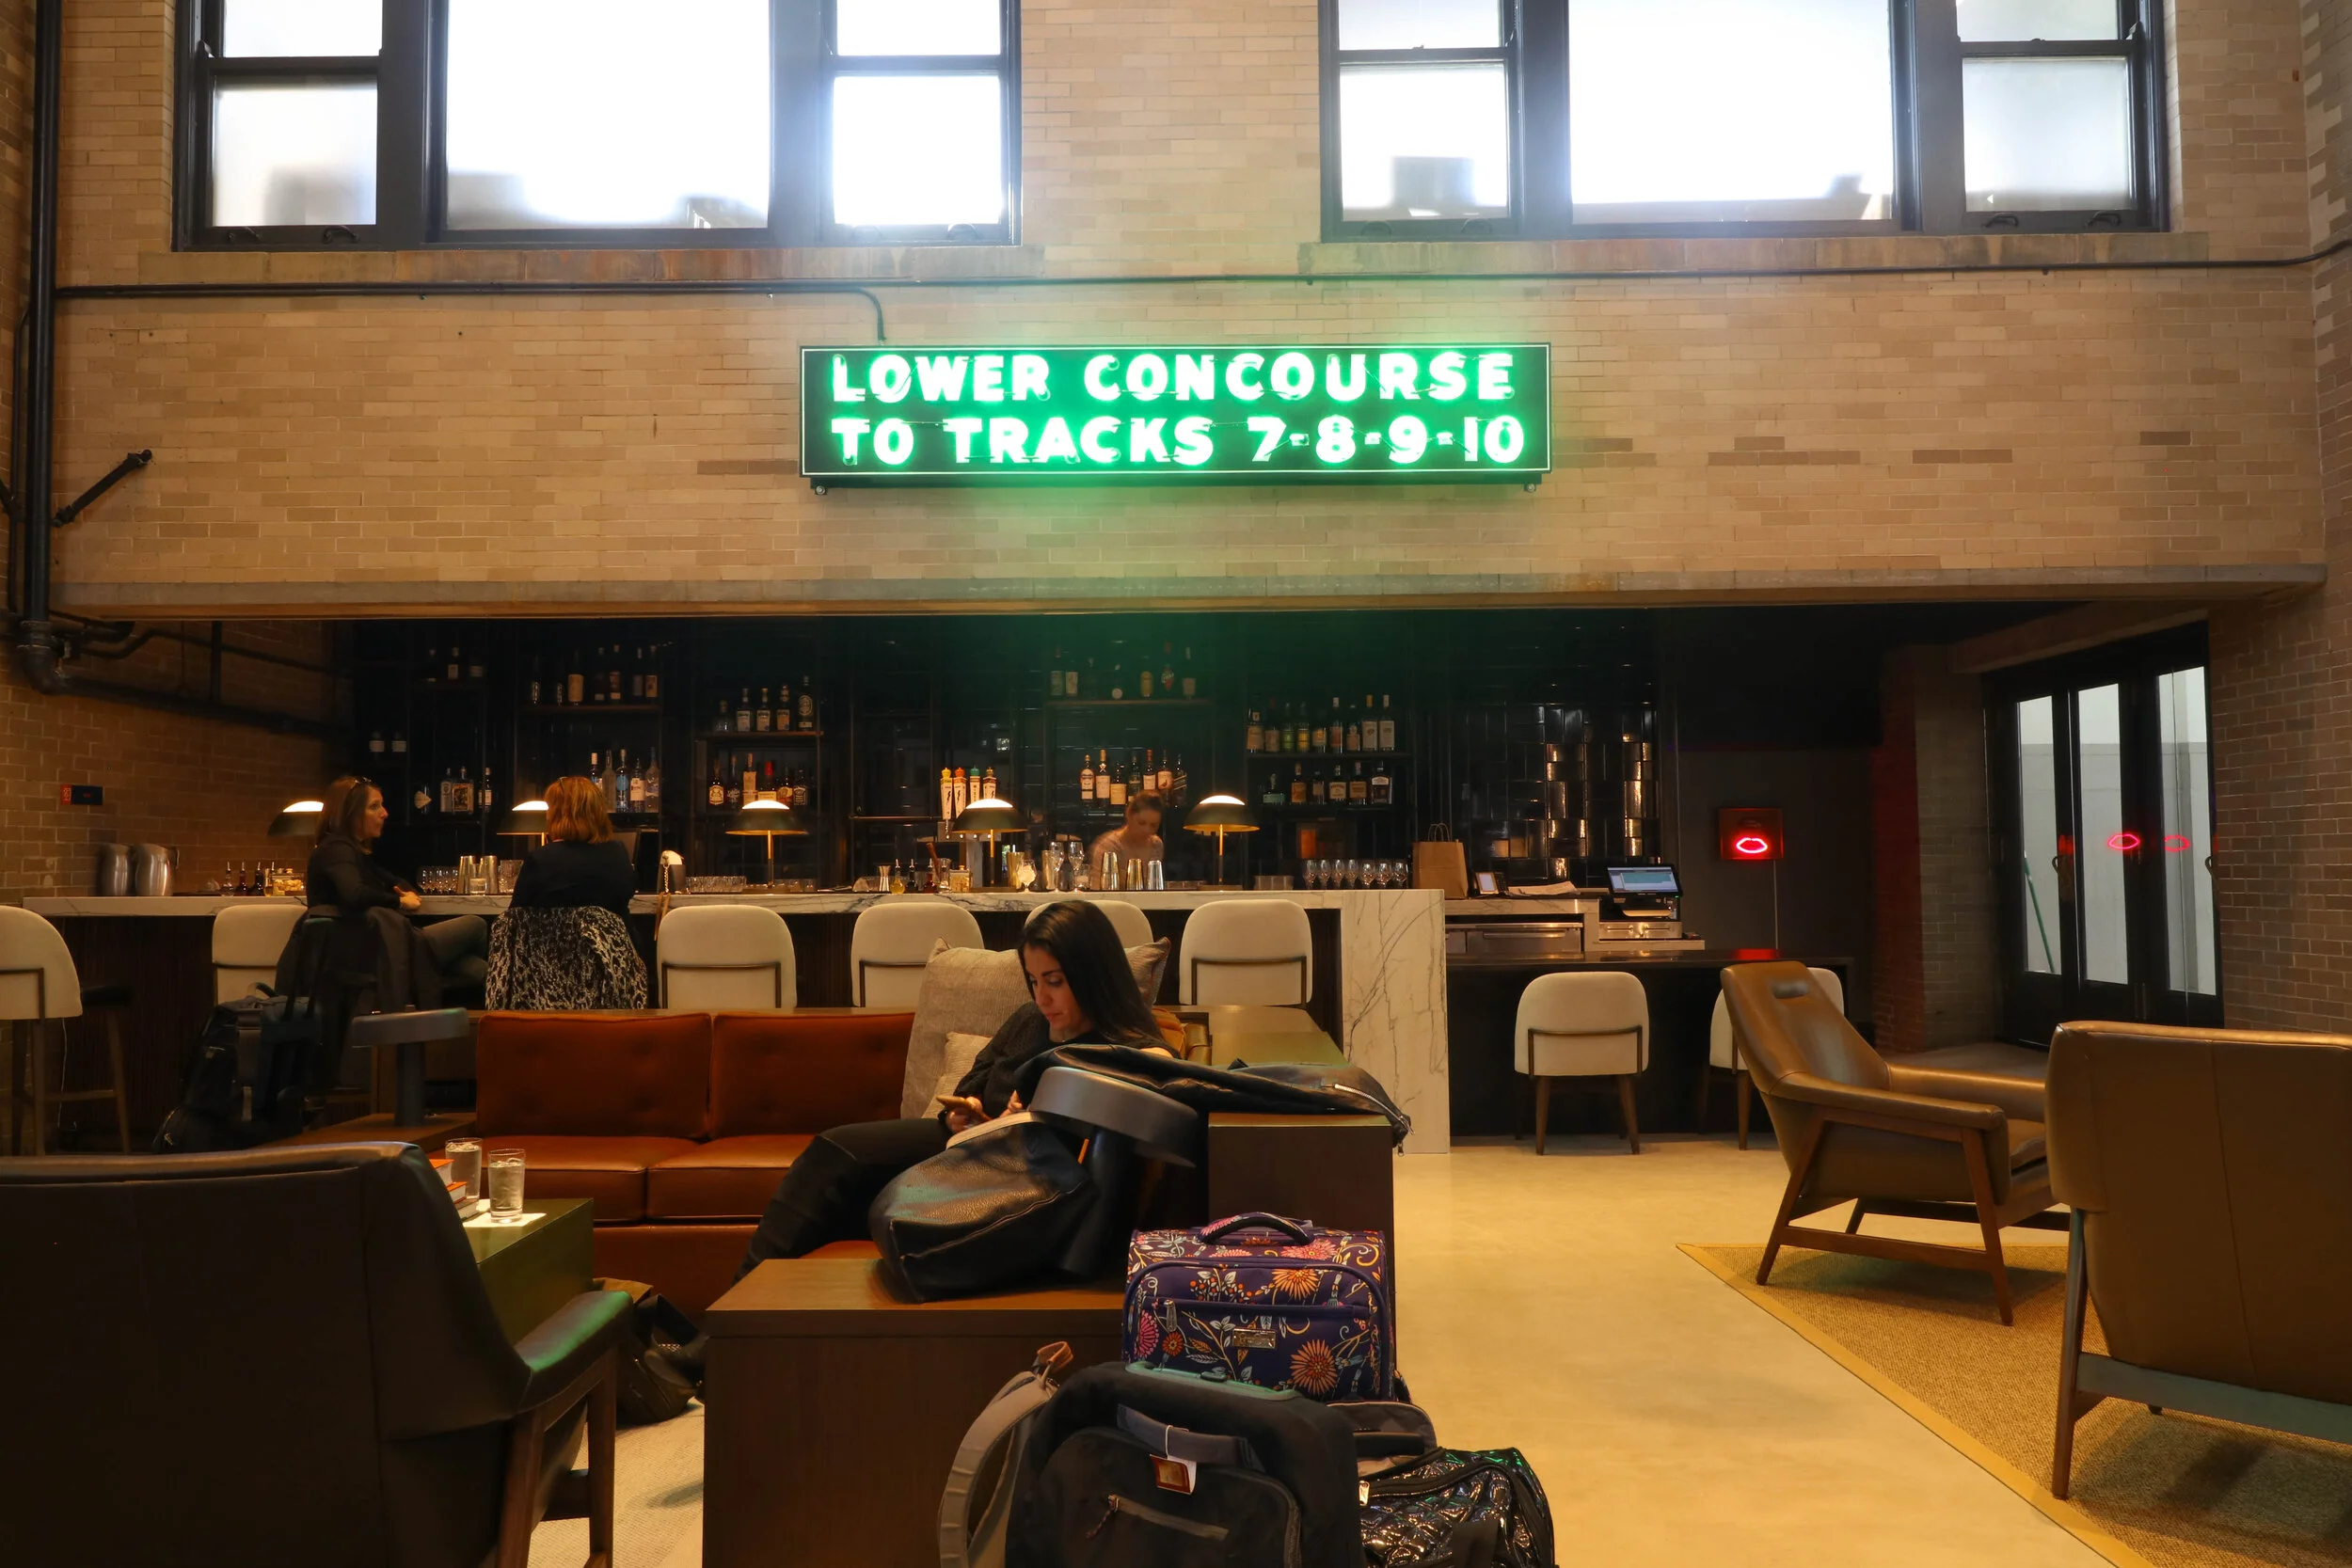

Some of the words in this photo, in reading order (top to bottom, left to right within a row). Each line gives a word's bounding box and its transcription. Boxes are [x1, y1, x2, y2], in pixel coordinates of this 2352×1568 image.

[832, 354, 1051, 403] LOWER
[1084, 352, 1514, 403] CONCOURSE
[831, 416, 914, 465] TO
[942, 416, 1214, 466] TRACKS
[1247, 415, 1525, 464] 7-8-9-10
